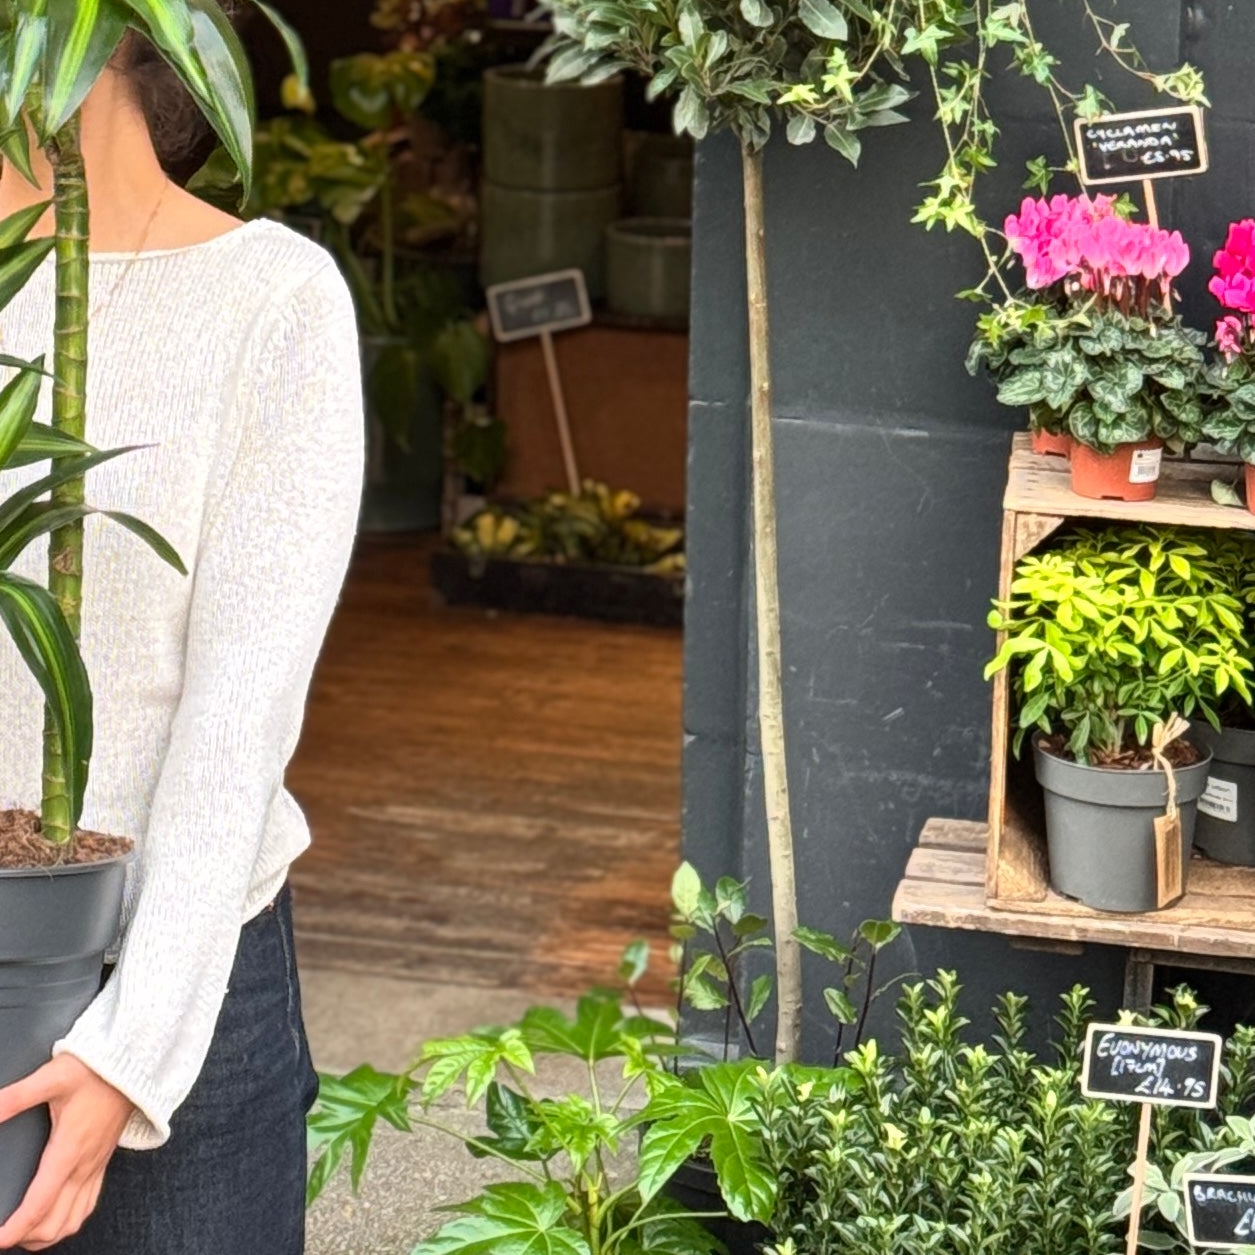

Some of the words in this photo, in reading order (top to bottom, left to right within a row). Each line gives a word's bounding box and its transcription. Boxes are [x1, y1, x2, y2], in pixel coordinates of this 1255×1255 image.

[1086, 121, 1177, 139] CYCLAMEN
[1097, 1032, 1198, 1062] EUONYMOUS
[1134, 1075, 1207, 1098] £14.95
